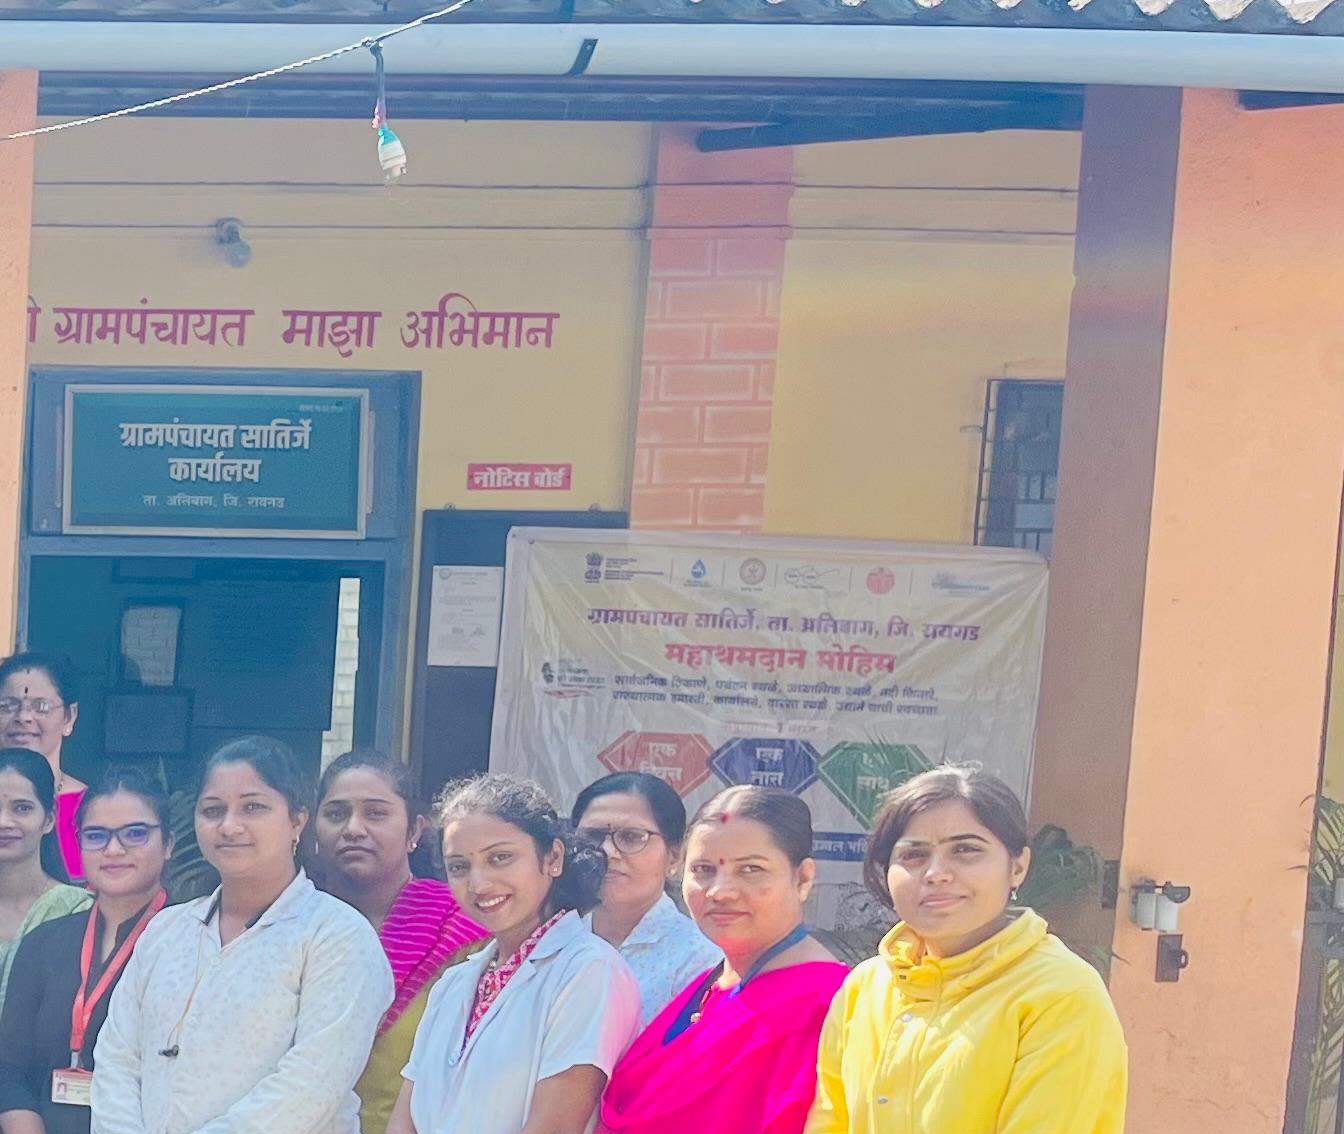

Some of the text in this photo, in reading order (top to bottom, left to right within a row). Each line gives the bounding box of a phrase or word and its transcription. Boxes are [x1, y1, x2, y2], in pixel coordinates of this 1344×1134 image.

[53, 297, 255, 347] ग्रामपंचायत
[282, 308, 381, 358] माझा
[400, 292, 560, 351] अभिमान
[119, 417, 312, 450] ग्रामपंचायत सातिर्जे
[168, 452, 261, 483] कार्यालय
[473, 467, 566, 488] नोटिस बोर्ड
[922, 623, 981, 641] रायगड
